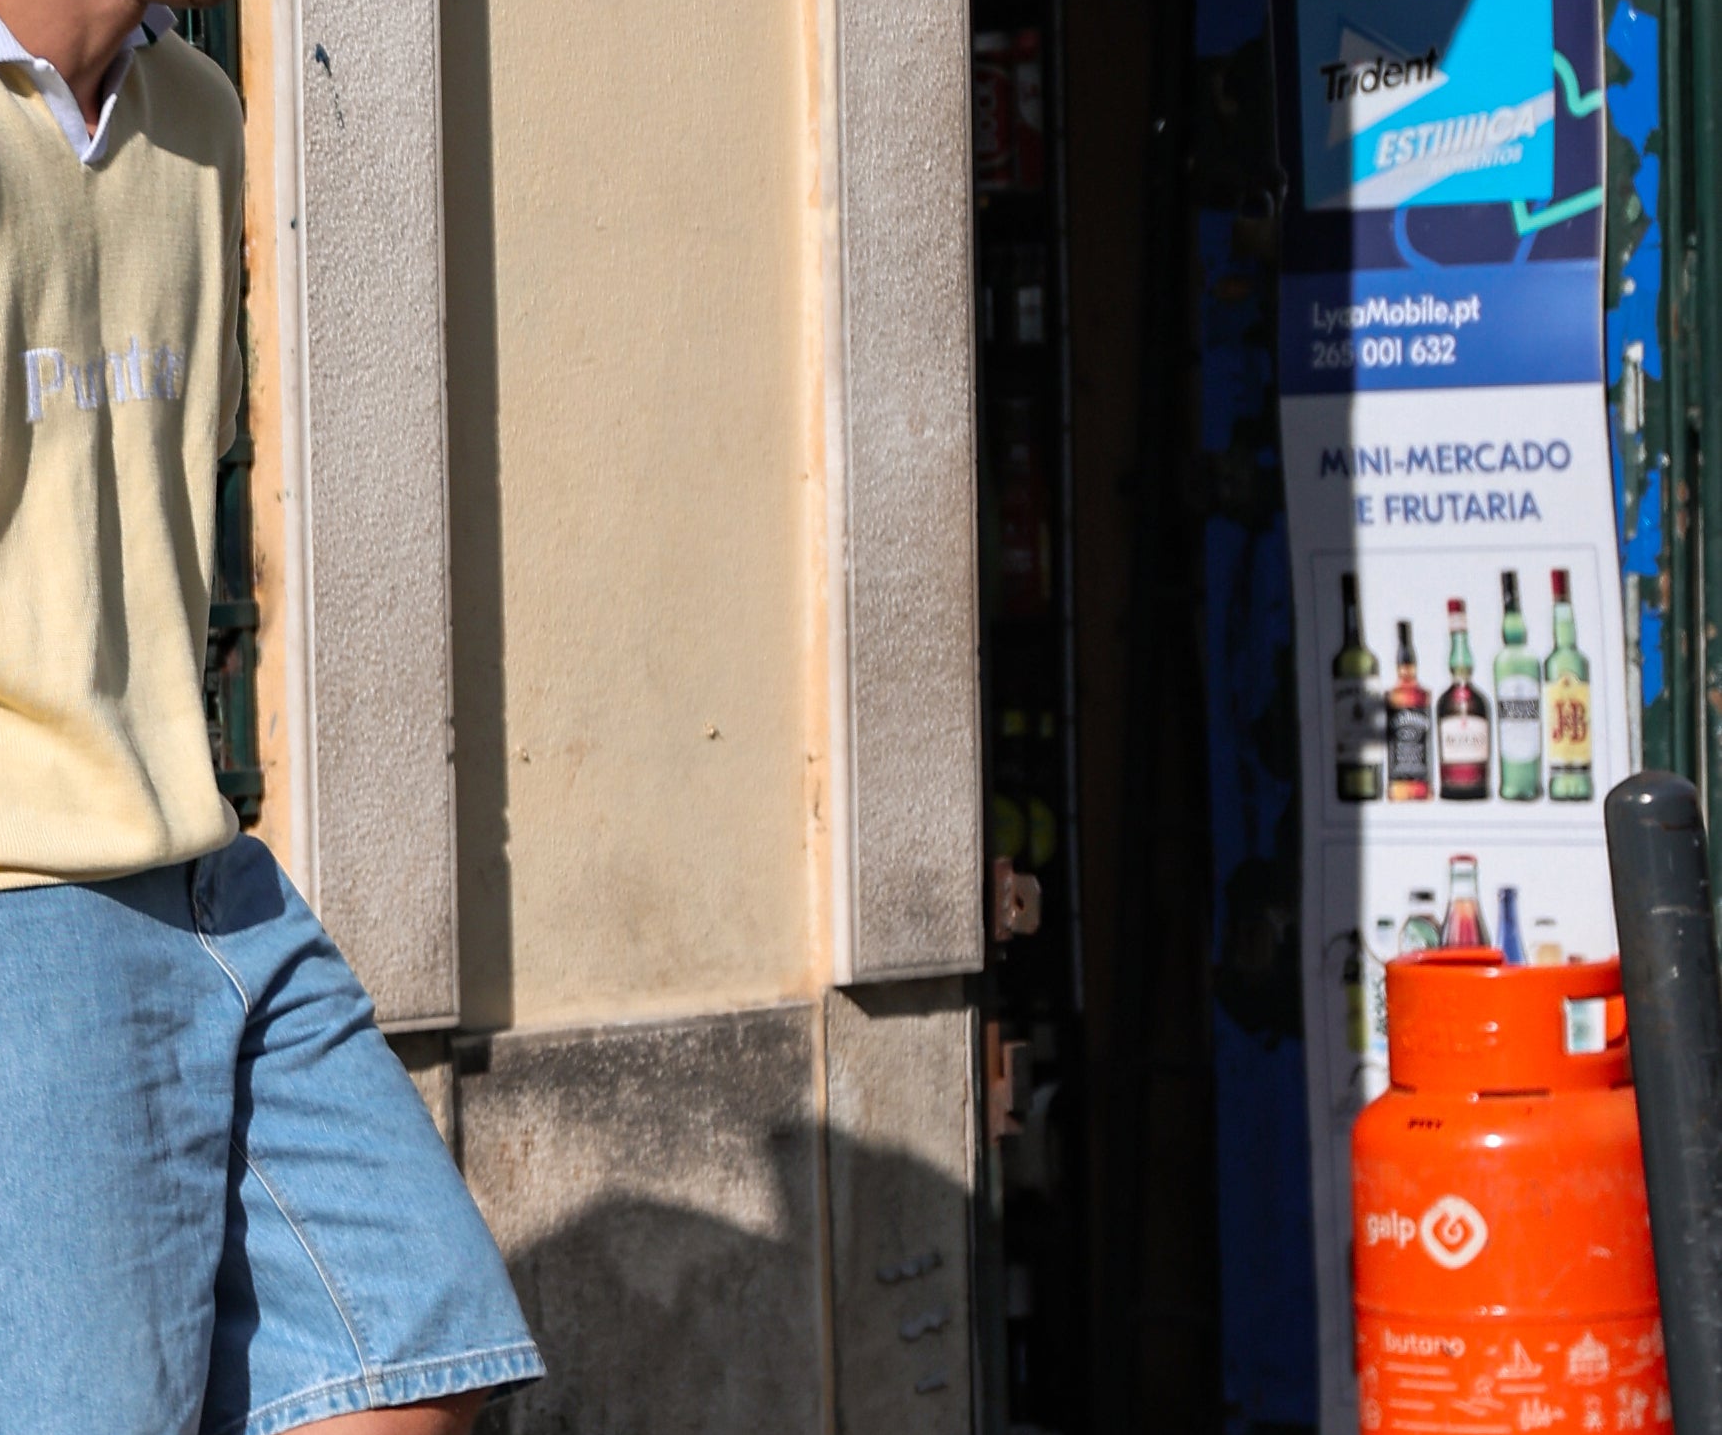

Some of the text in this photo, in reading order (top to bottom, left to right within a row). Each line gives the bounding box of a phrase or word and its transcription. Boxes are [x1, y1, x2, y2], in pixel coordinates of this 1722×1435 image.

[1320, 48, 1439, 103] Trident
[1313, 294, 1481, 333] LycaMobile.pt
[1312, 333, 1457, 368] 265 001 632
[1320, 439, 1572, 479] MINI-MERCADO
[1355, 491, 1543, 526] E FRUTARIA
[1365, 1208, 1418, 1250] galp
[1383, 1325, 1467, 1359] butano
